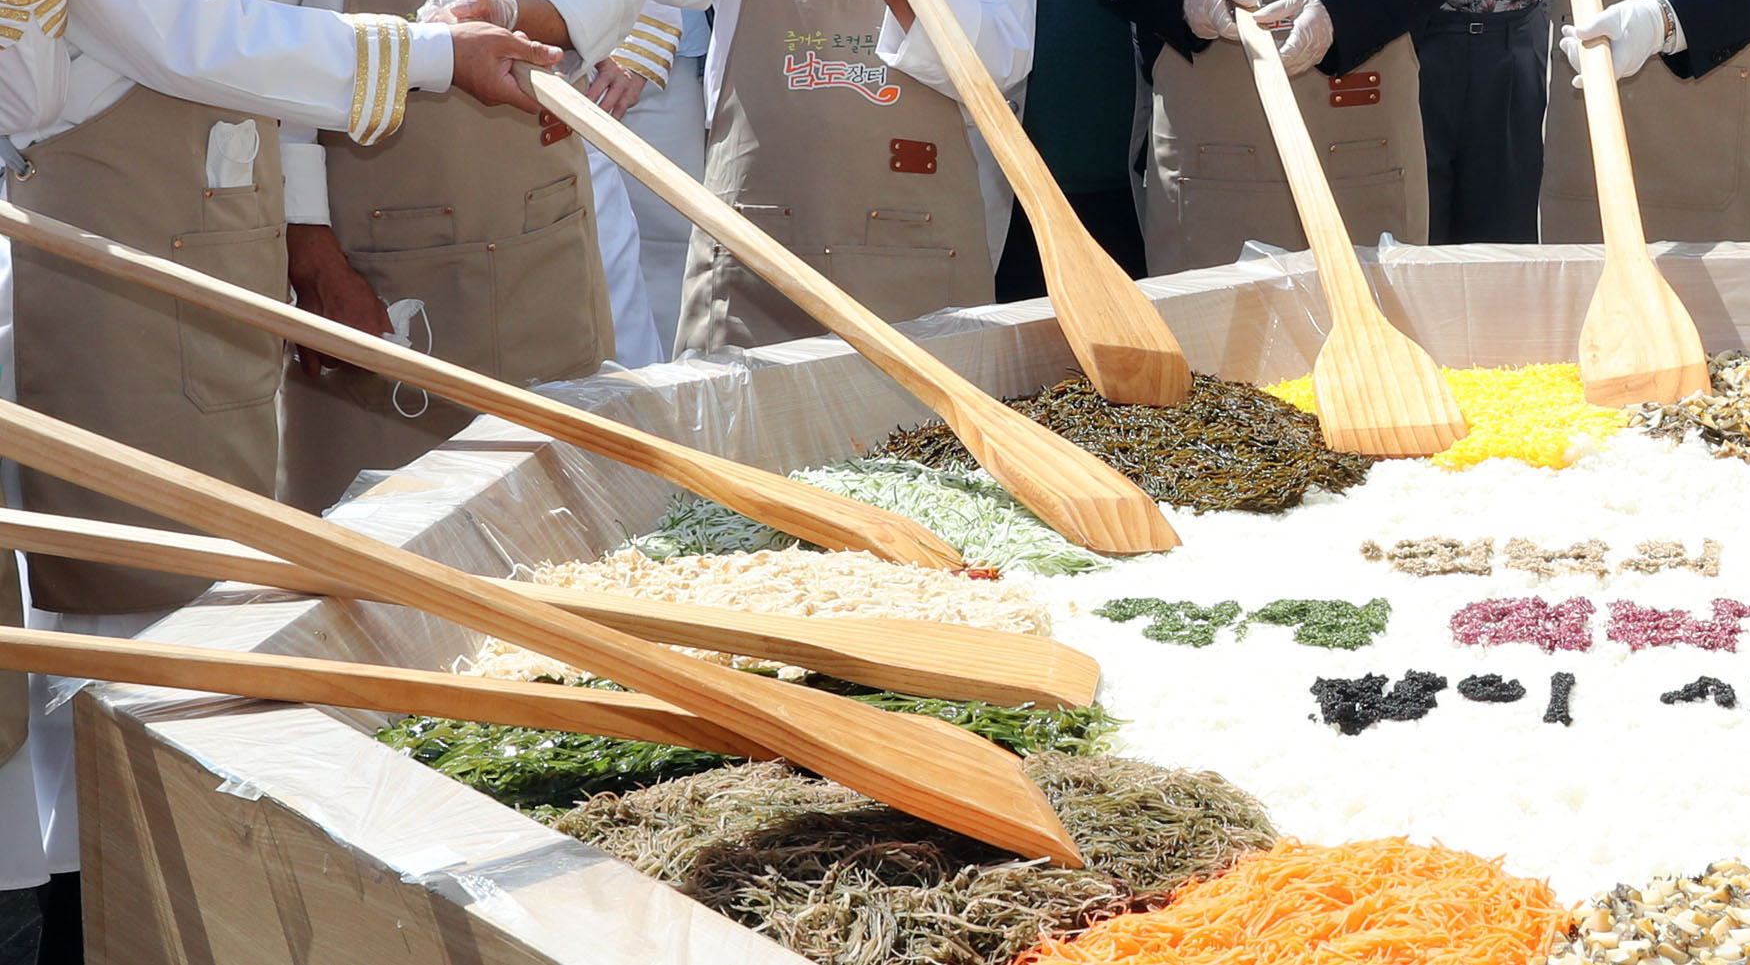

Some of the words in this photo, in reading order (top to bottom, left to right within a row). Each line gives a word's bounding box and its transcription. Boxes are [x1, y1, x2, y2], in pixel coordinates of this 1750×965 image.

[783, 30, 828, 51] 즐거운
[831, 34, 876, 55] 로컬푸
[784, 51, 888, 90] 남도장터
[1308, 668, 1575, 736] 많이
